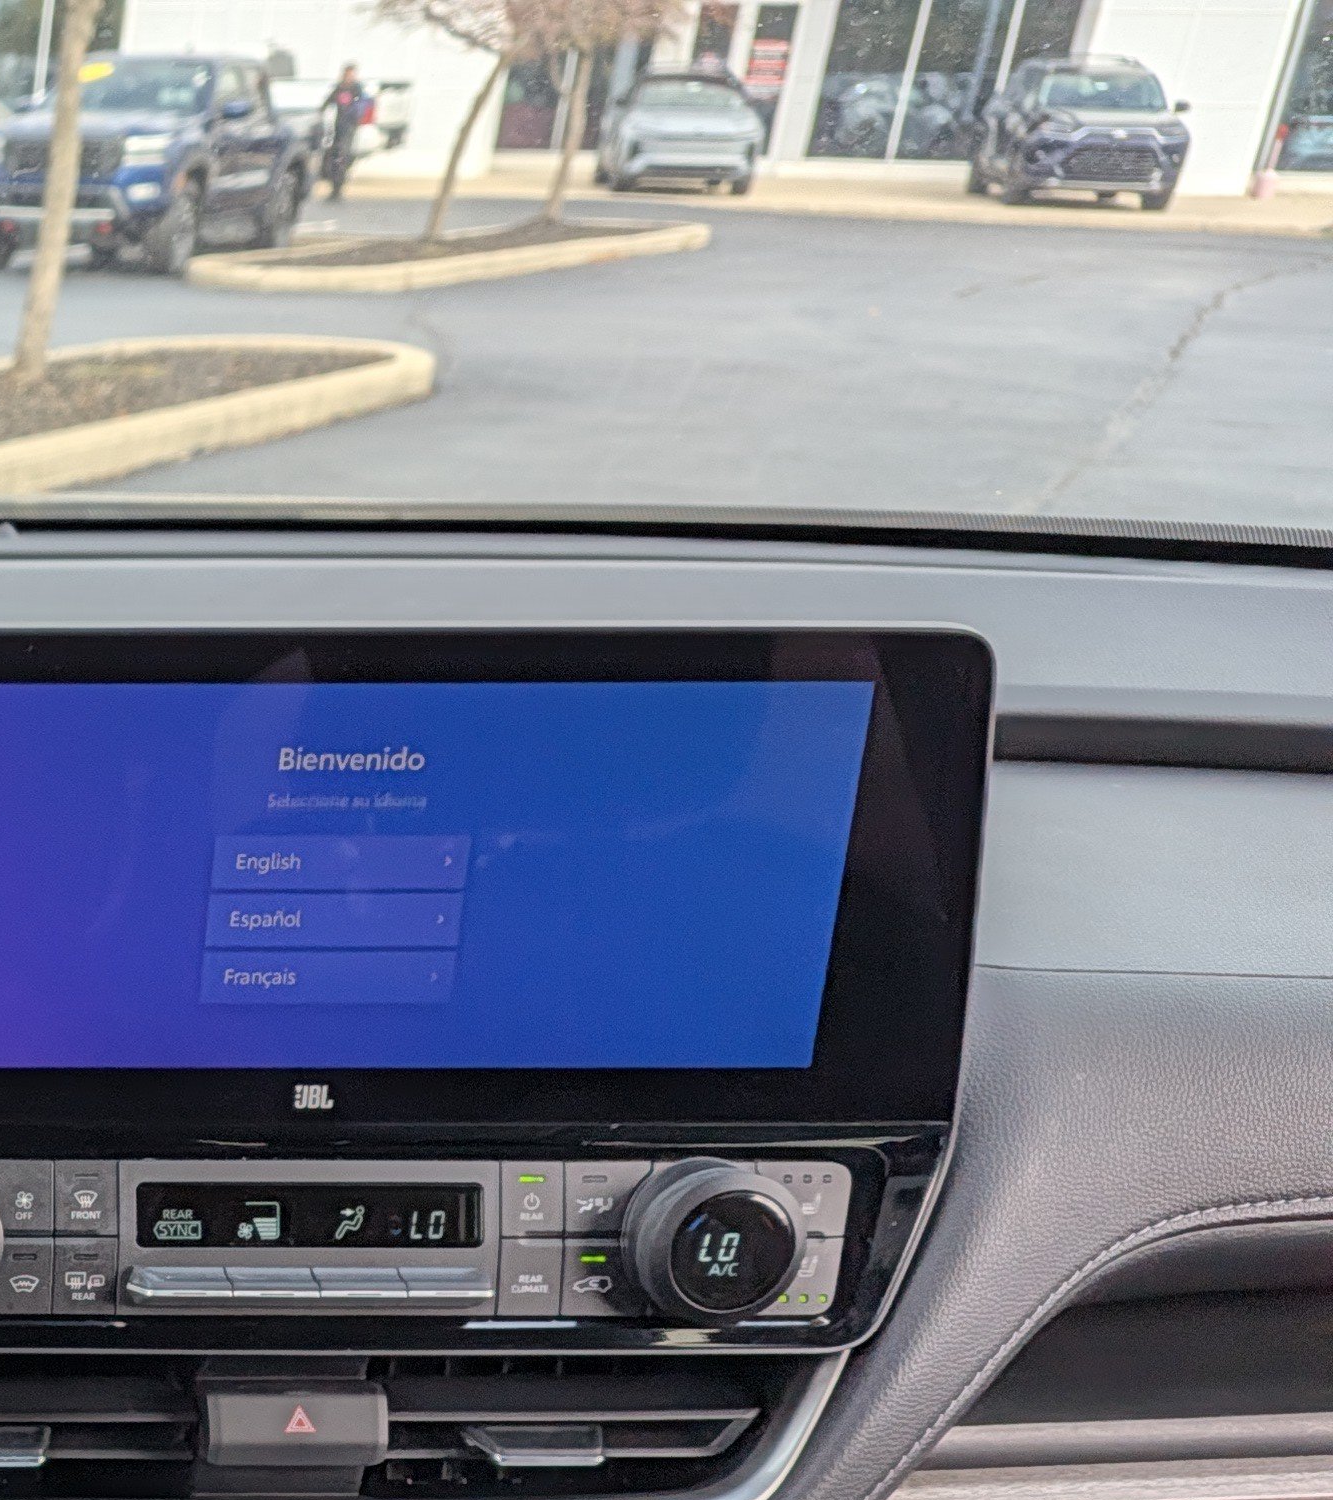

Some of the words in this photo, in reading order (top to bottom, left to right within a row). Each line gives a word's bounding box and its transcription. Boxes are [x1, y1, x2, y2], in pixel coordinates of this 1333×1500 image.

[278, 746, 425, 771] Bienvenido
[236, 853, 301, 873] English
[229, 910, 301, 930] Español
[223, 967, 296, 988] Français
[294, 1084, 333, 1108] JBL
[15, 1211, 33, 1219] OFF
[70, 1210, 101, 1219] FRONT
[162, 1208, 193, 1219] REAR
[158, 1224, 197, 1236] SYNC
[707, 1262, 739, 1276] A/C
[71, 1292, 96, 1300] REAR
